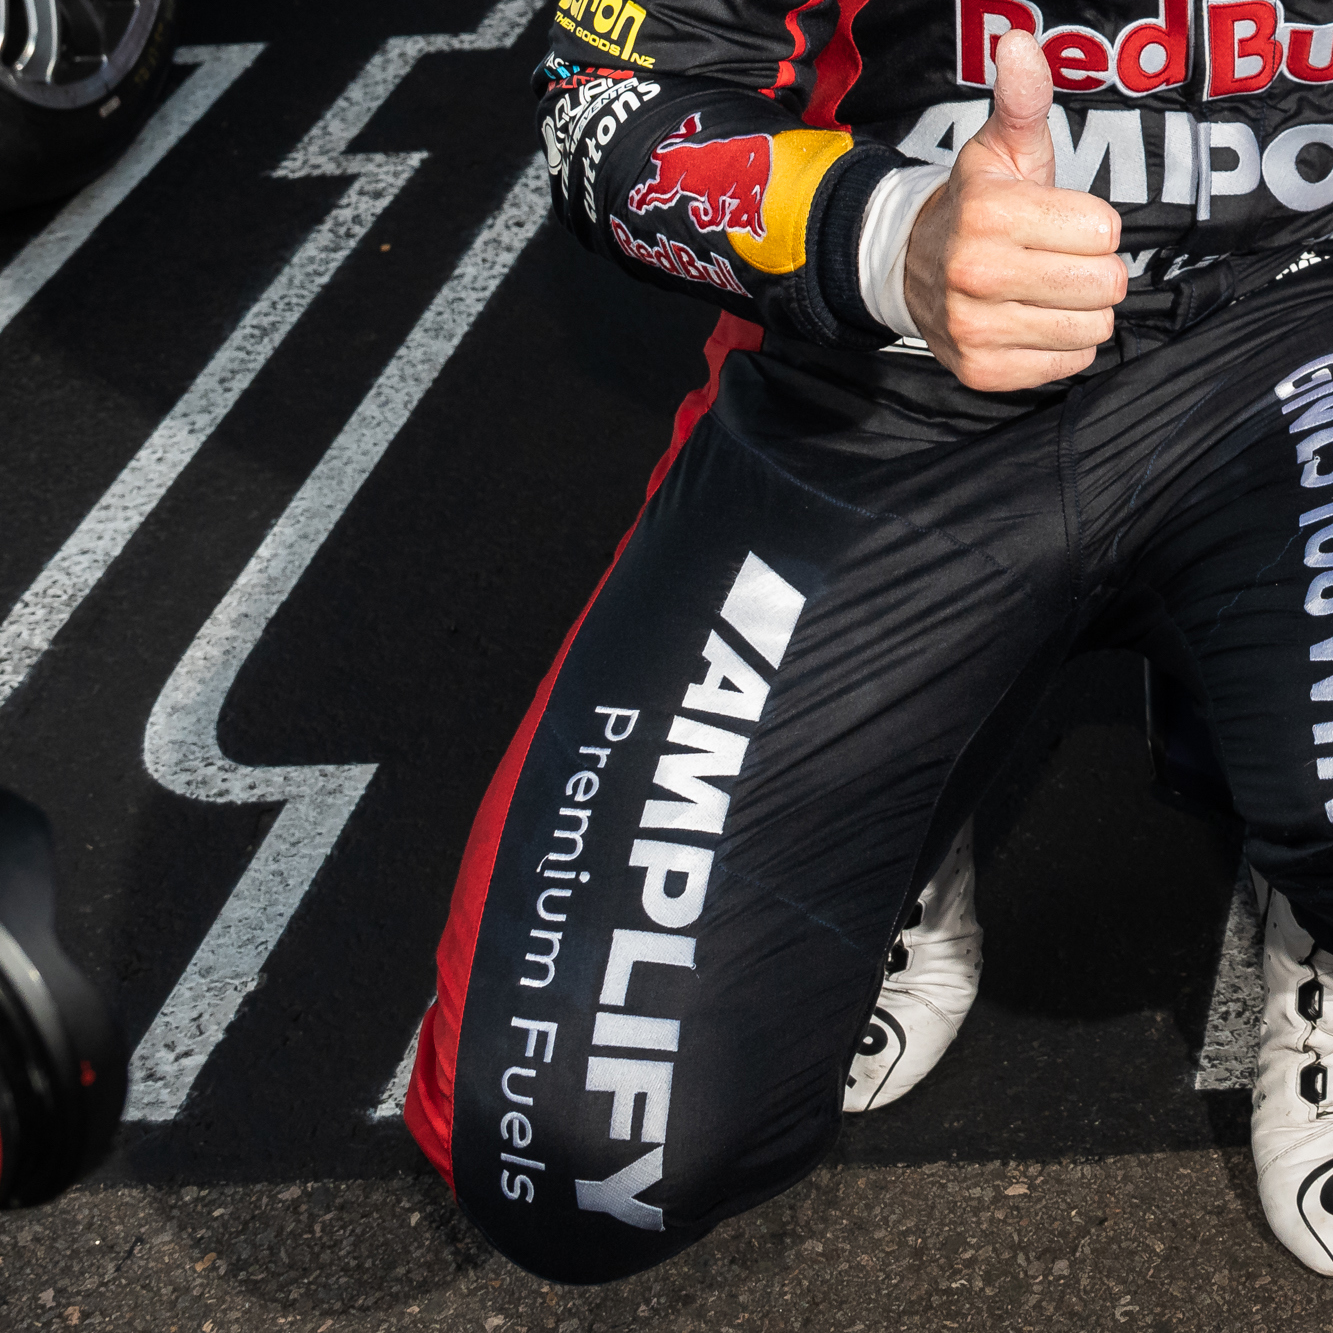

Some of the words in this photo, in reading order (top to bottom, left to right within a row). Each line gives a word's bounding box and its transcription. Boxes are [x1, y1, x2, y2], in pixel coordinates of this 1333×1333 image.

[554, 11, 576, 33] THER
[575, 25, 621, 57] GOODS
[630, 52, 656, 69] NZ
[518, 705, 642, 990] Premium
[574, 628, 771, 1233] AMPLIFY
[499, 1016, 558, 1206] Fuels
